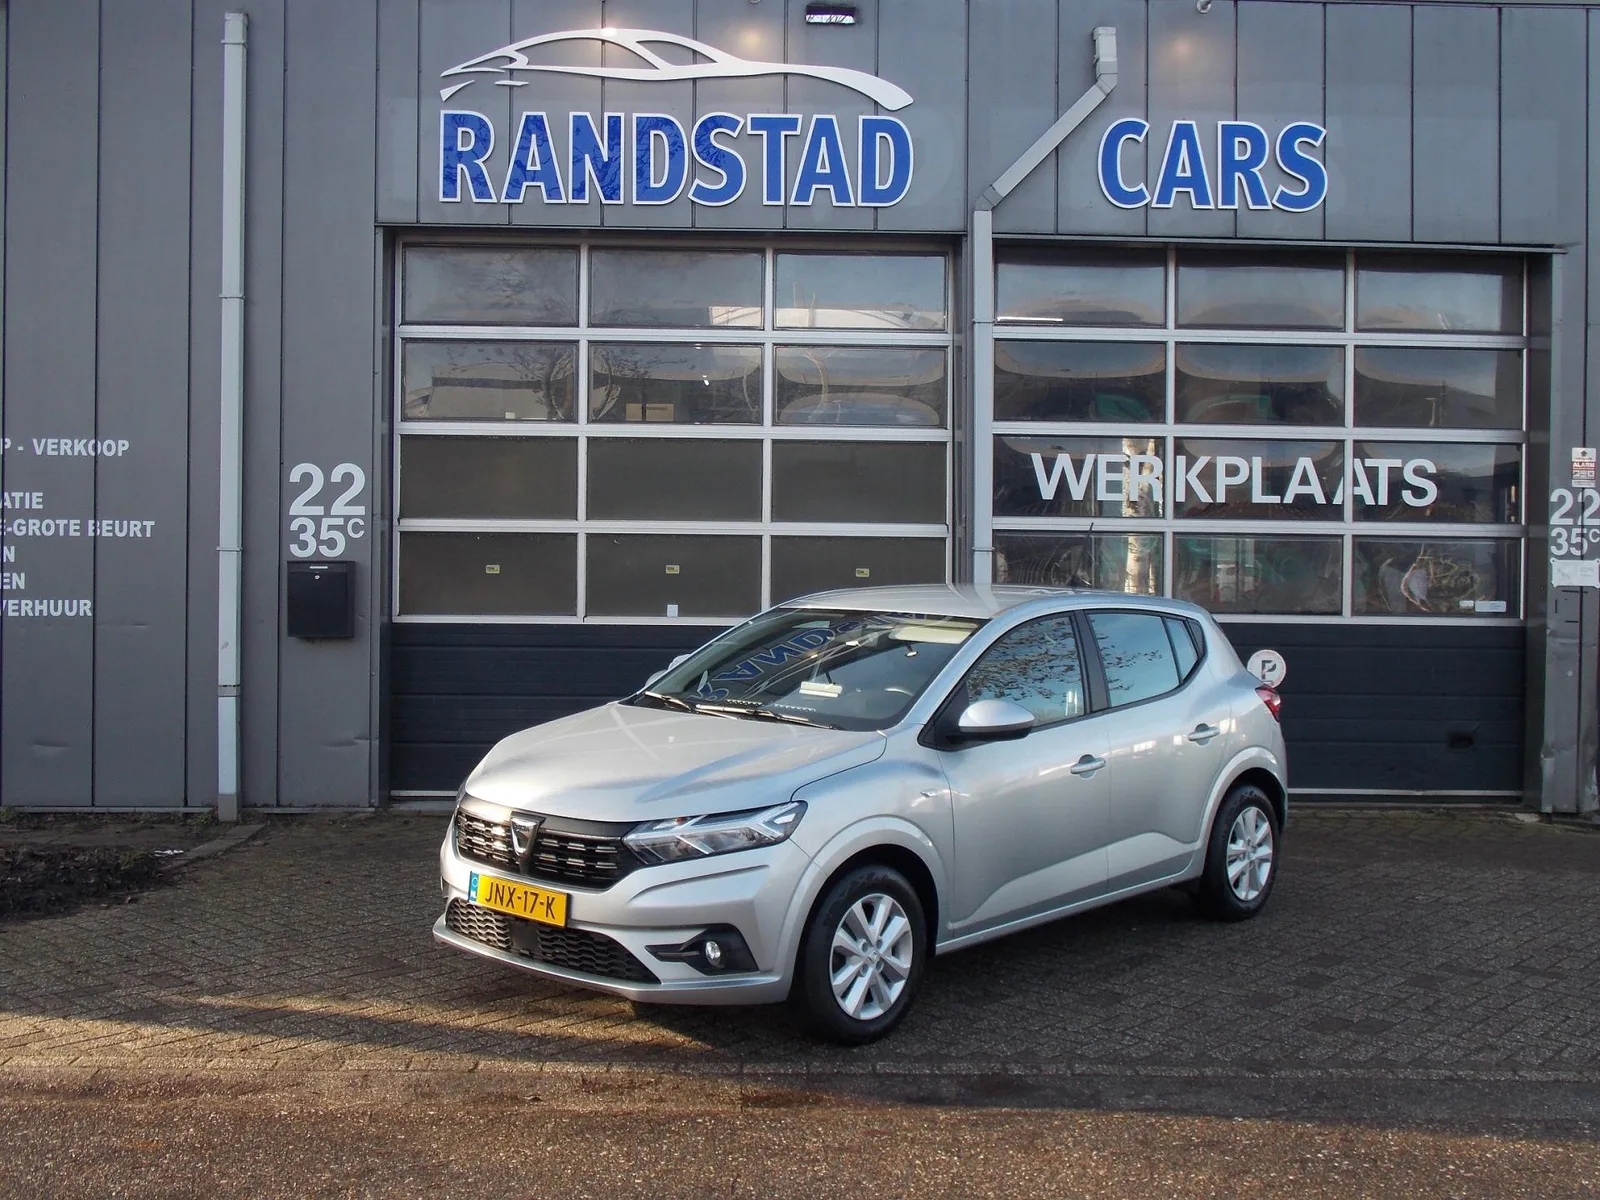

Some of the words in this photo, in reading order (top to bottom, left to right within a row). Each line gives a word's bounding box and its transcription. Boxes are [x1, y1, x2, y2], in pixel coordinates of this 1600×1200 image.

[439, 109, 914, 207] RANDSTAD
[1098, 117, 1328, 212] CARS
[32, 438, 130, 457] VERKOOP
[289, 463, 366, 516] 22
[1030, 453, 1438, 507] WERKPLAATS
[1550, 488, 1600, 525] 22
[88, 520, 155, 537] BEURT
[485, 882, 555, 920] JNX-17-K
